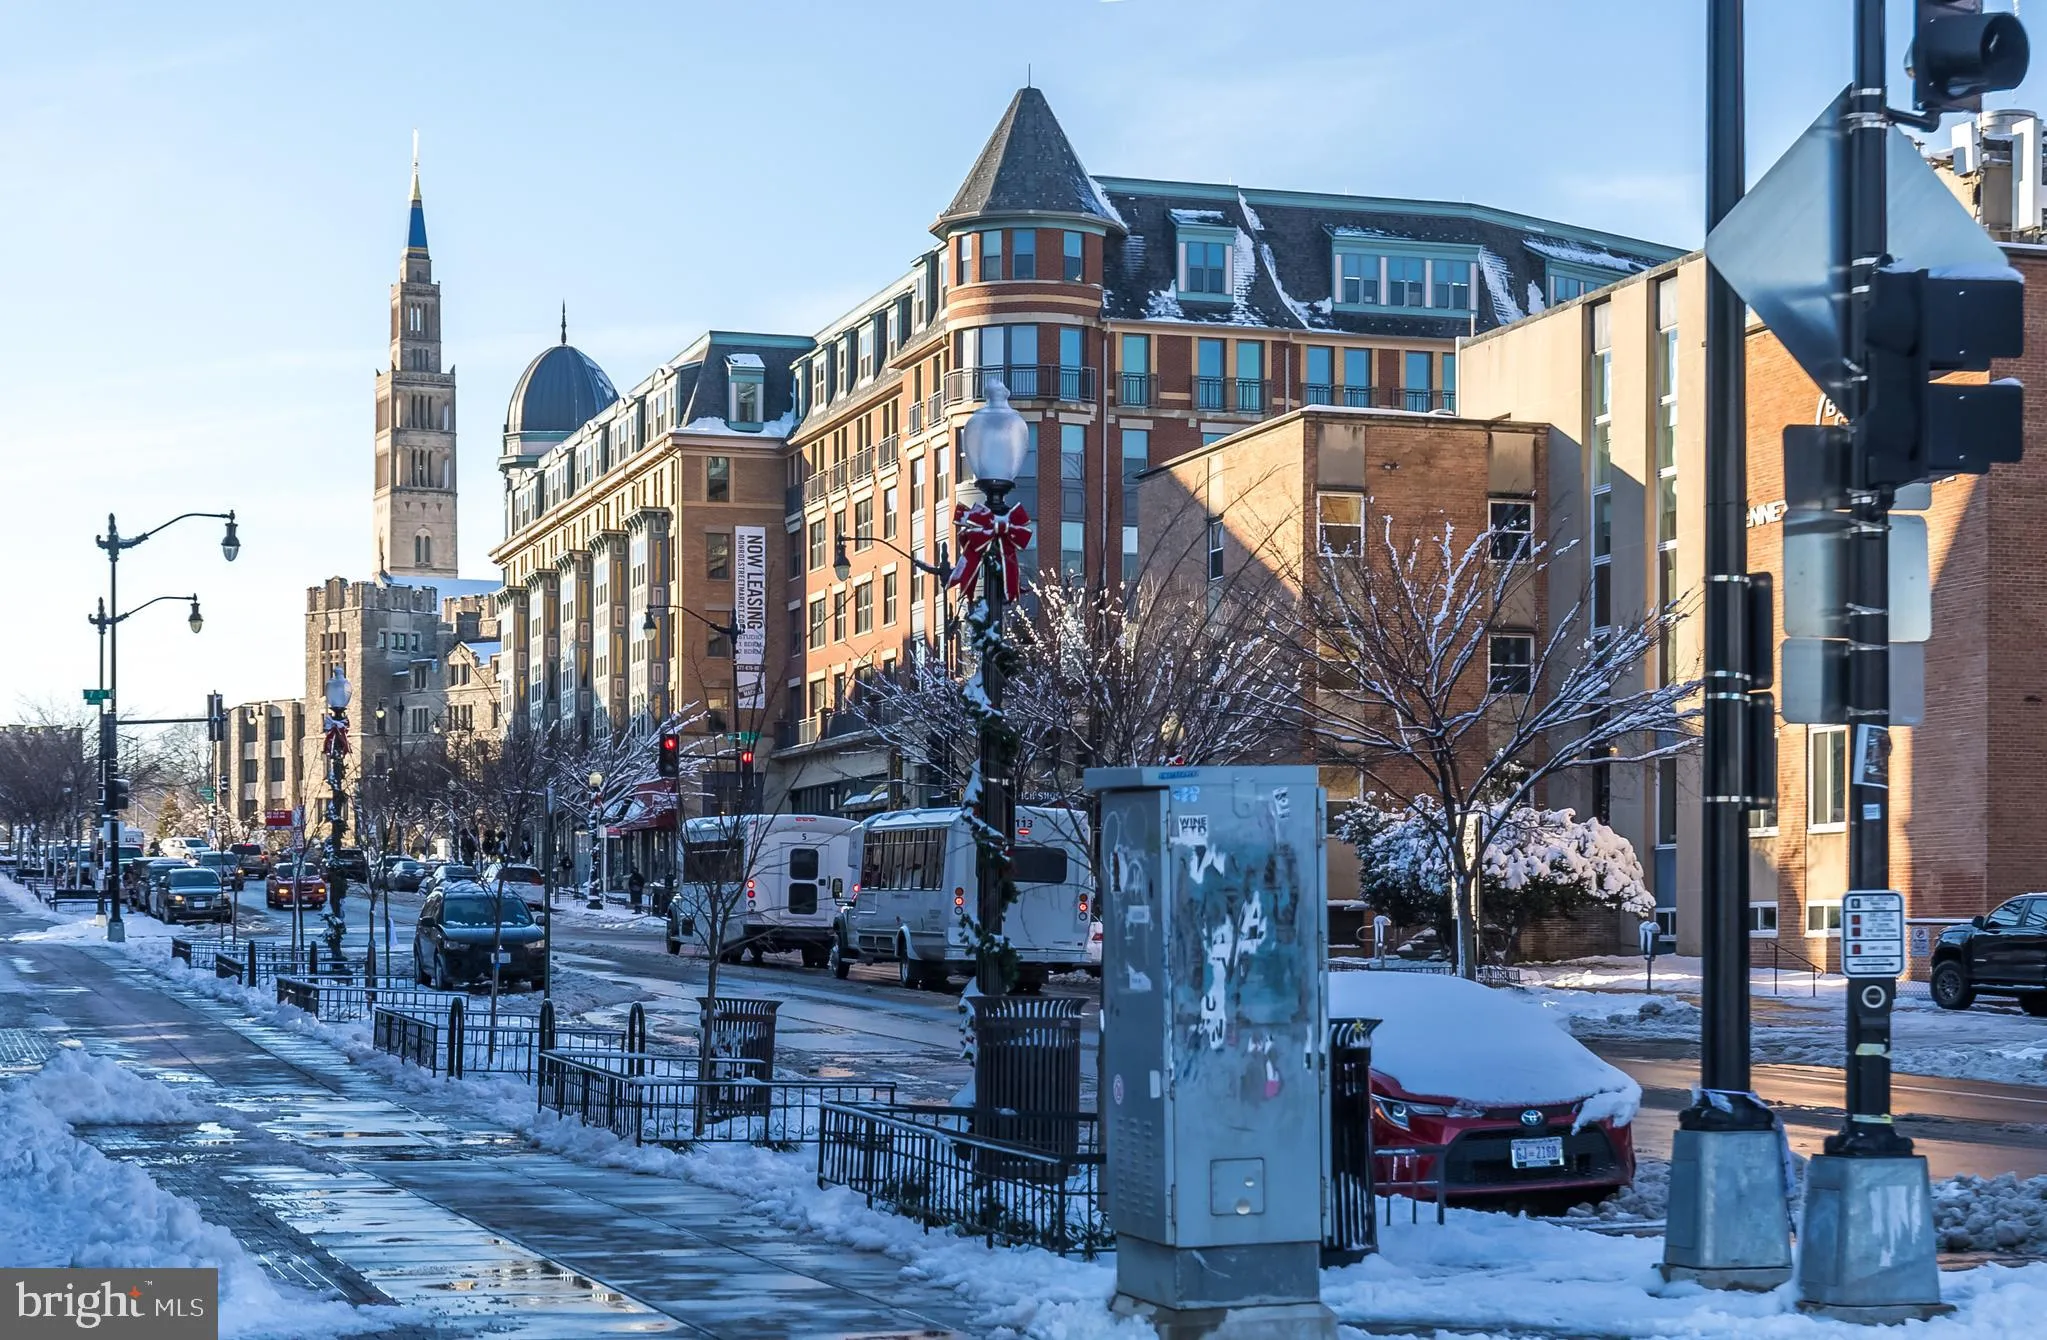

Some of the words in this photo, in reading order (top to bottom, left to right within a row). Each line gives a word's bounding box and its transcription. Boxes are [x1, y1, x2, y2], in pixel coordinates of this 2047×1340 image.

[747, 535, 763, 568] NOW
[738, 534, 746, 629] MONROESTREETMARKET.CO
[747, 572, 763, 630] LEASING
[1015, 819, 1033, 828] 113
[1179, 816, 1208, 826] WINE
[801, 833, 807, 841] 5
